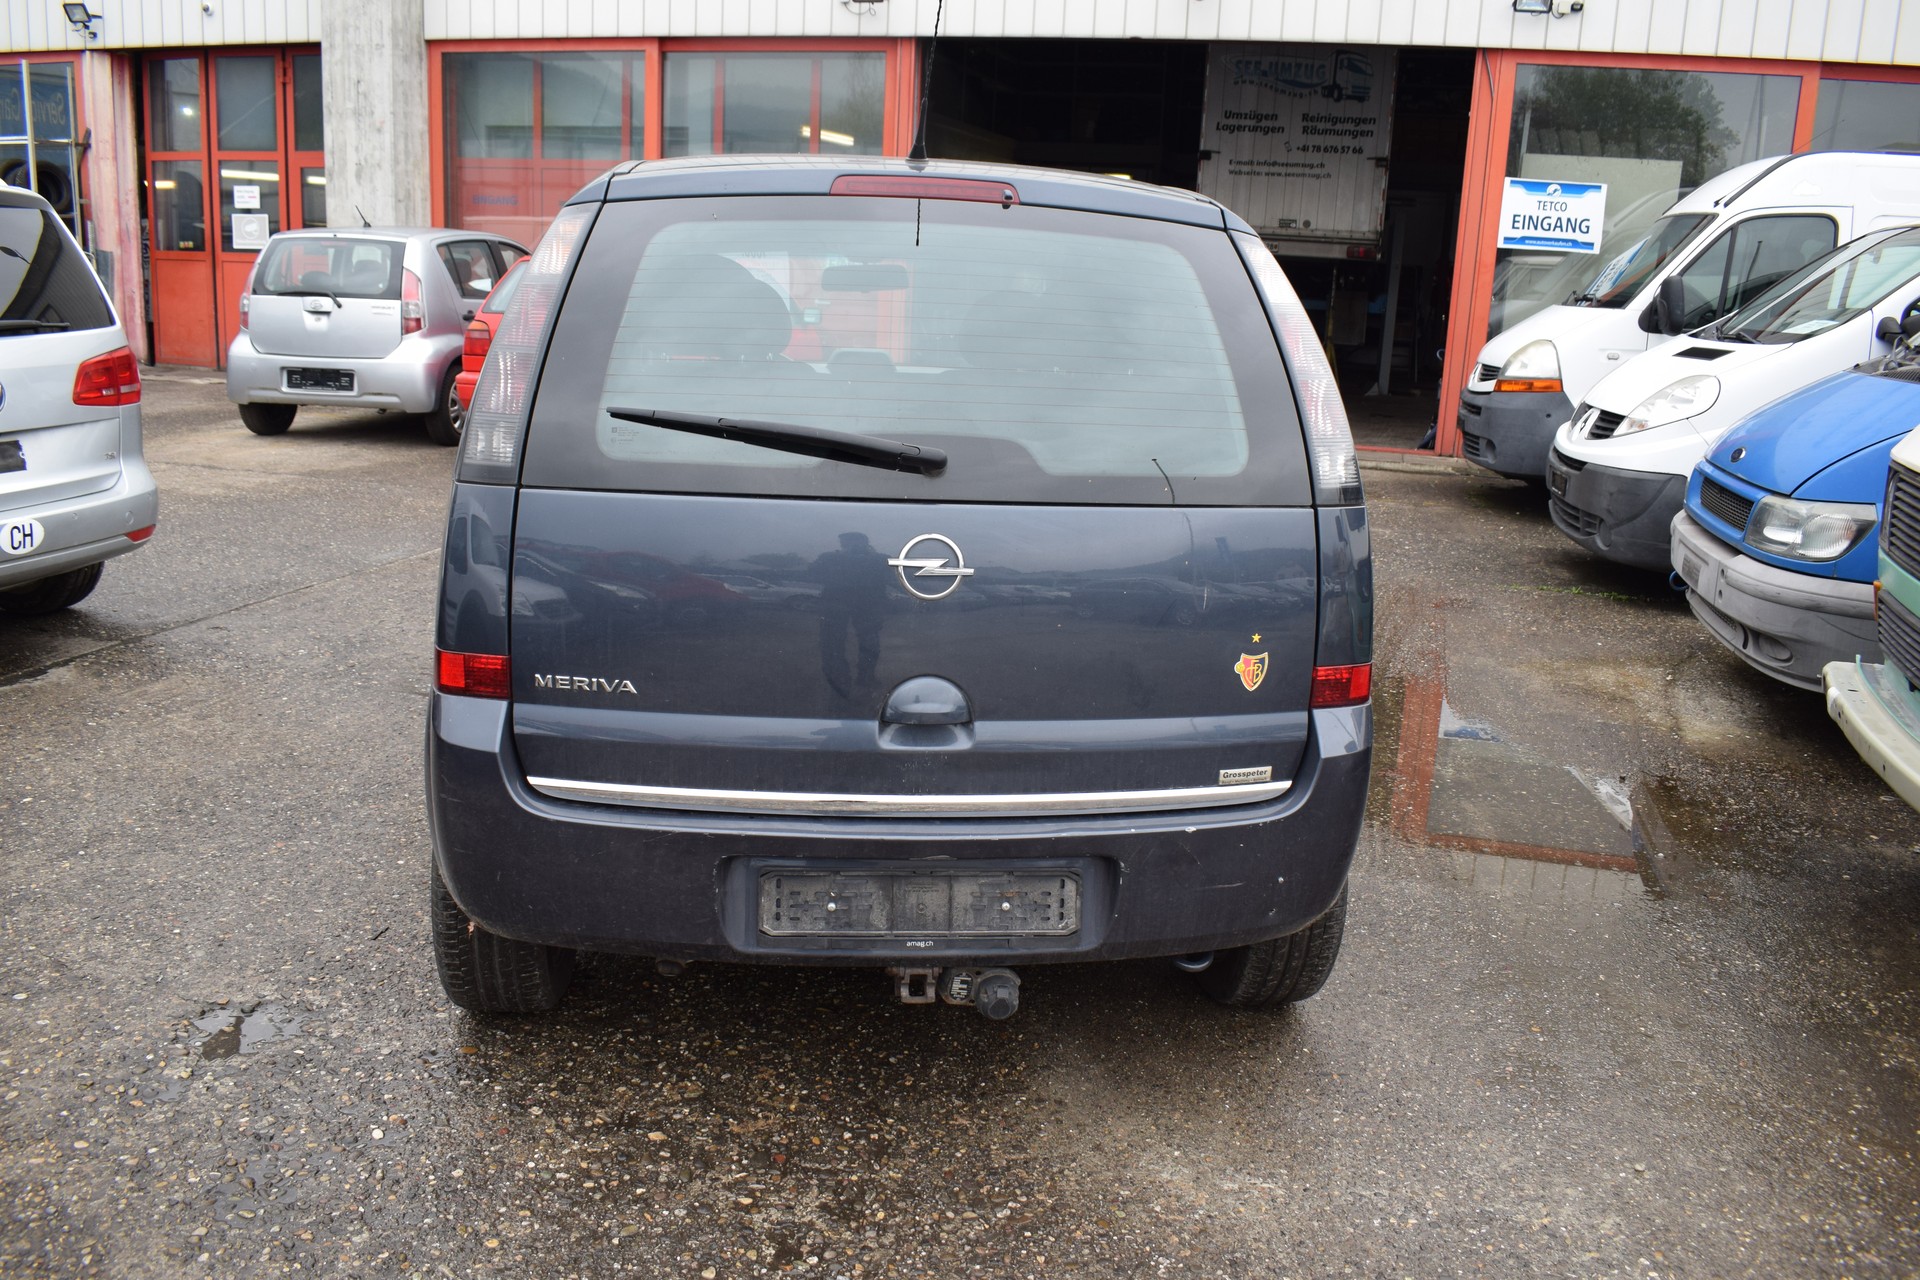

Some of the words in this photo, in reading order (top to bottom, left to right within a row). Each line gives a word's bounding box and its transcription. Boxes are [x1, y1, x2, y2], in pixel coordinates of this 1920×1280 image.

[1223, 110, 1278, 123] Umzügen
[1301, 113, 1377, 127] Reinigungen
[1215, 121, 1285, 135] Lagerungen
[1301, 125, 1374, 139] Räumungen
[1311, 144, 1322, 153] 78
[1323, 145, 1339, 154] 676
[1340, 145, 1351, 154] 57
[1352, 146, 1364, 155] 66
[1537, 200, 1568, 212] TETCO
[1511, 214, 1591, 234] EINGANG
[10, 523, 34, 551] CH
[534, 673, 638, 694] MERIVA
[1222, 769, 1268, 779] Grosspeter
[906, 940, 934, 948] amag.ch
